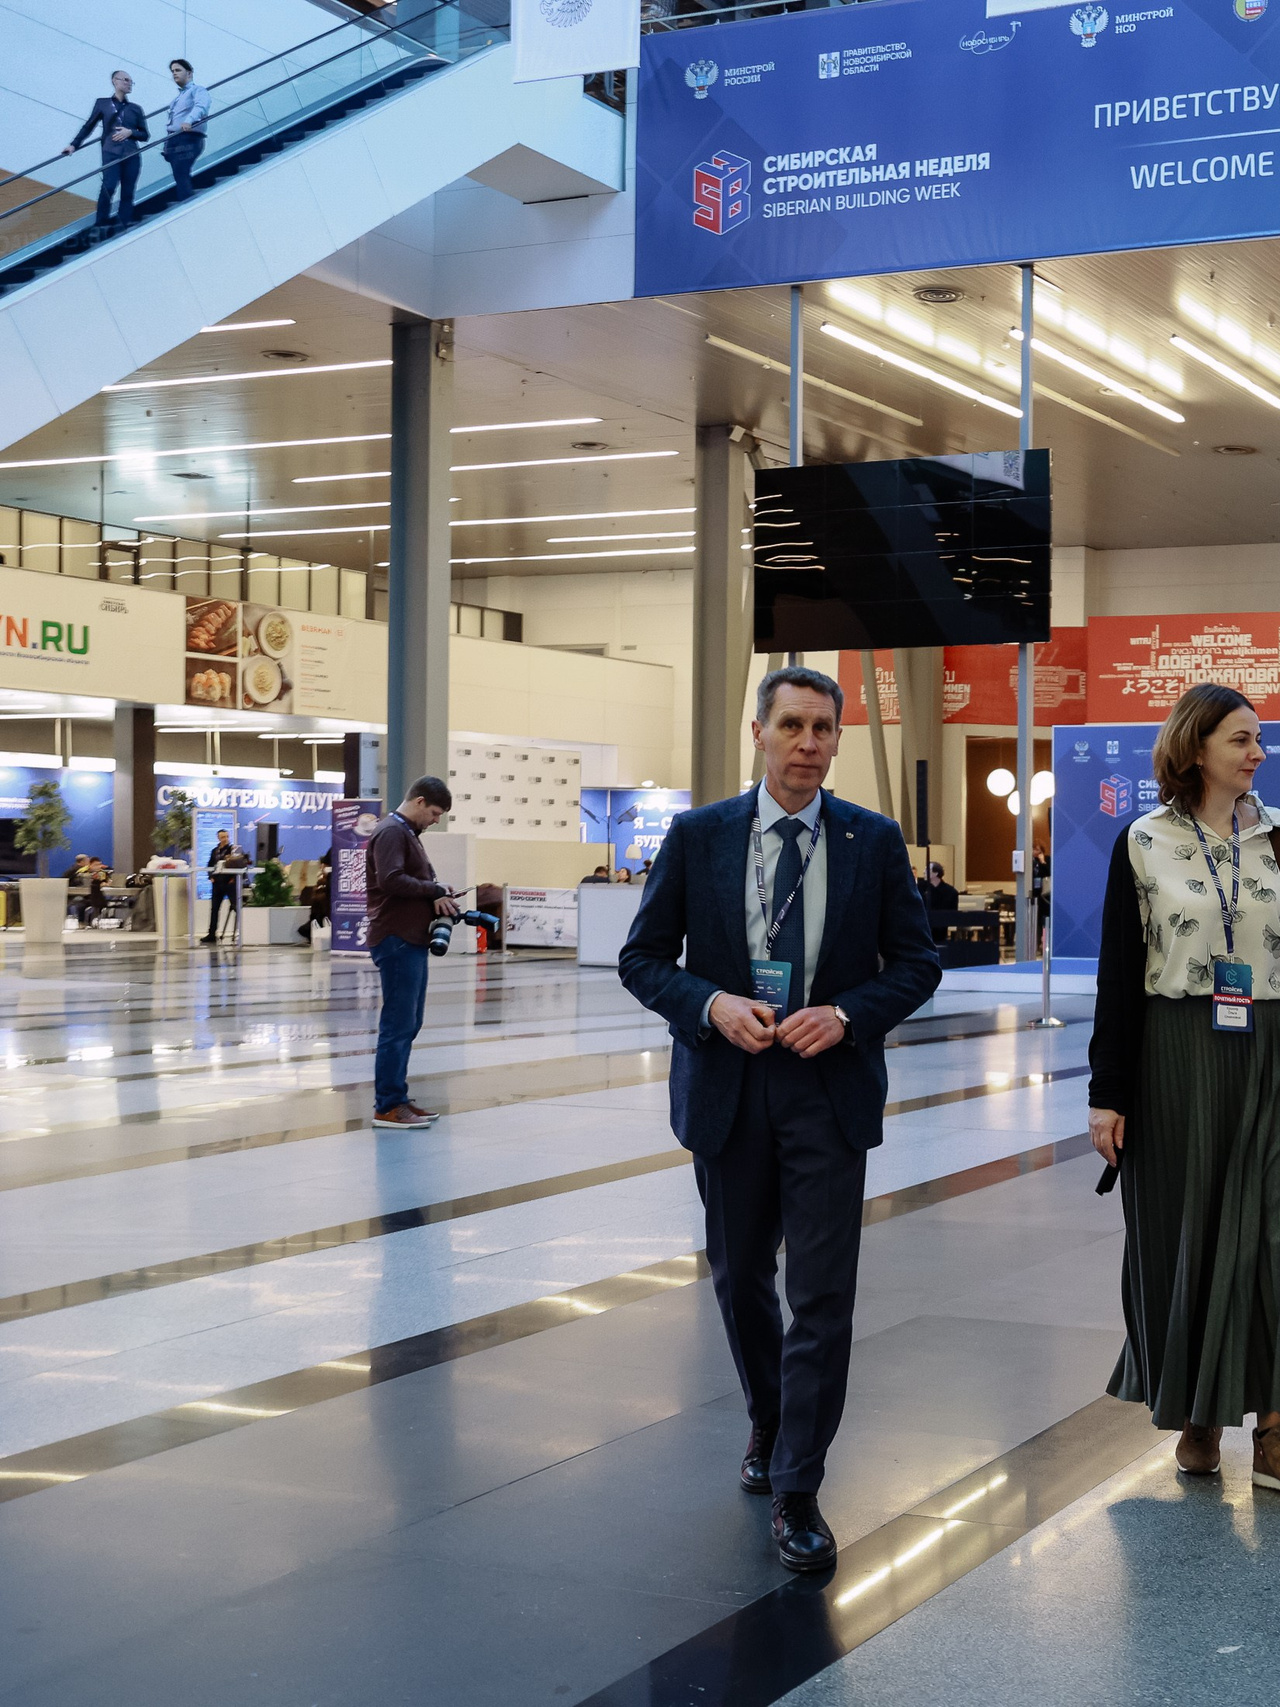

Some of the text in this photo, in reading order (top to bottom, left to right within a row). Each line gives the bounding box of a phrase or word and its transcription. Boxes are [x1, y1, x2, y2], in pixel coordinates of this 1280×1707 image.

[1115, 6, 1174, 24] МИНСТРОЙ
[1115, 23, 1137, 34] НСО
[843, 42, 907, 58] ПРАВИТЕЛЬСТВО
[843, 50, 912, 67] НОВОСИБИРСКОЙ
[724, 61, 775, 77] МИНСТРОЙ
[843, 64, 879, 76] ОБЛАСТИ
[724, 74, 761, 86] РОССИИ
[763, 143, 877, 173] СИБИРСКАЯ
[762, 152, 991, 195] СТРОИТЕЛЬНАЯ НЕДЕЛЯ
[1130, 151, 1274, 190] WELCOME
[762, 182, 962, 218] SIBERIAN BUILDING WEEK
[0, 614, 90, 655] N.RU
[1190, 634, 1252, 647] WELCOME
[1158, 654, 1213, 669] ДОБРО
[1122, 679, 1179, 694] ようこそ
